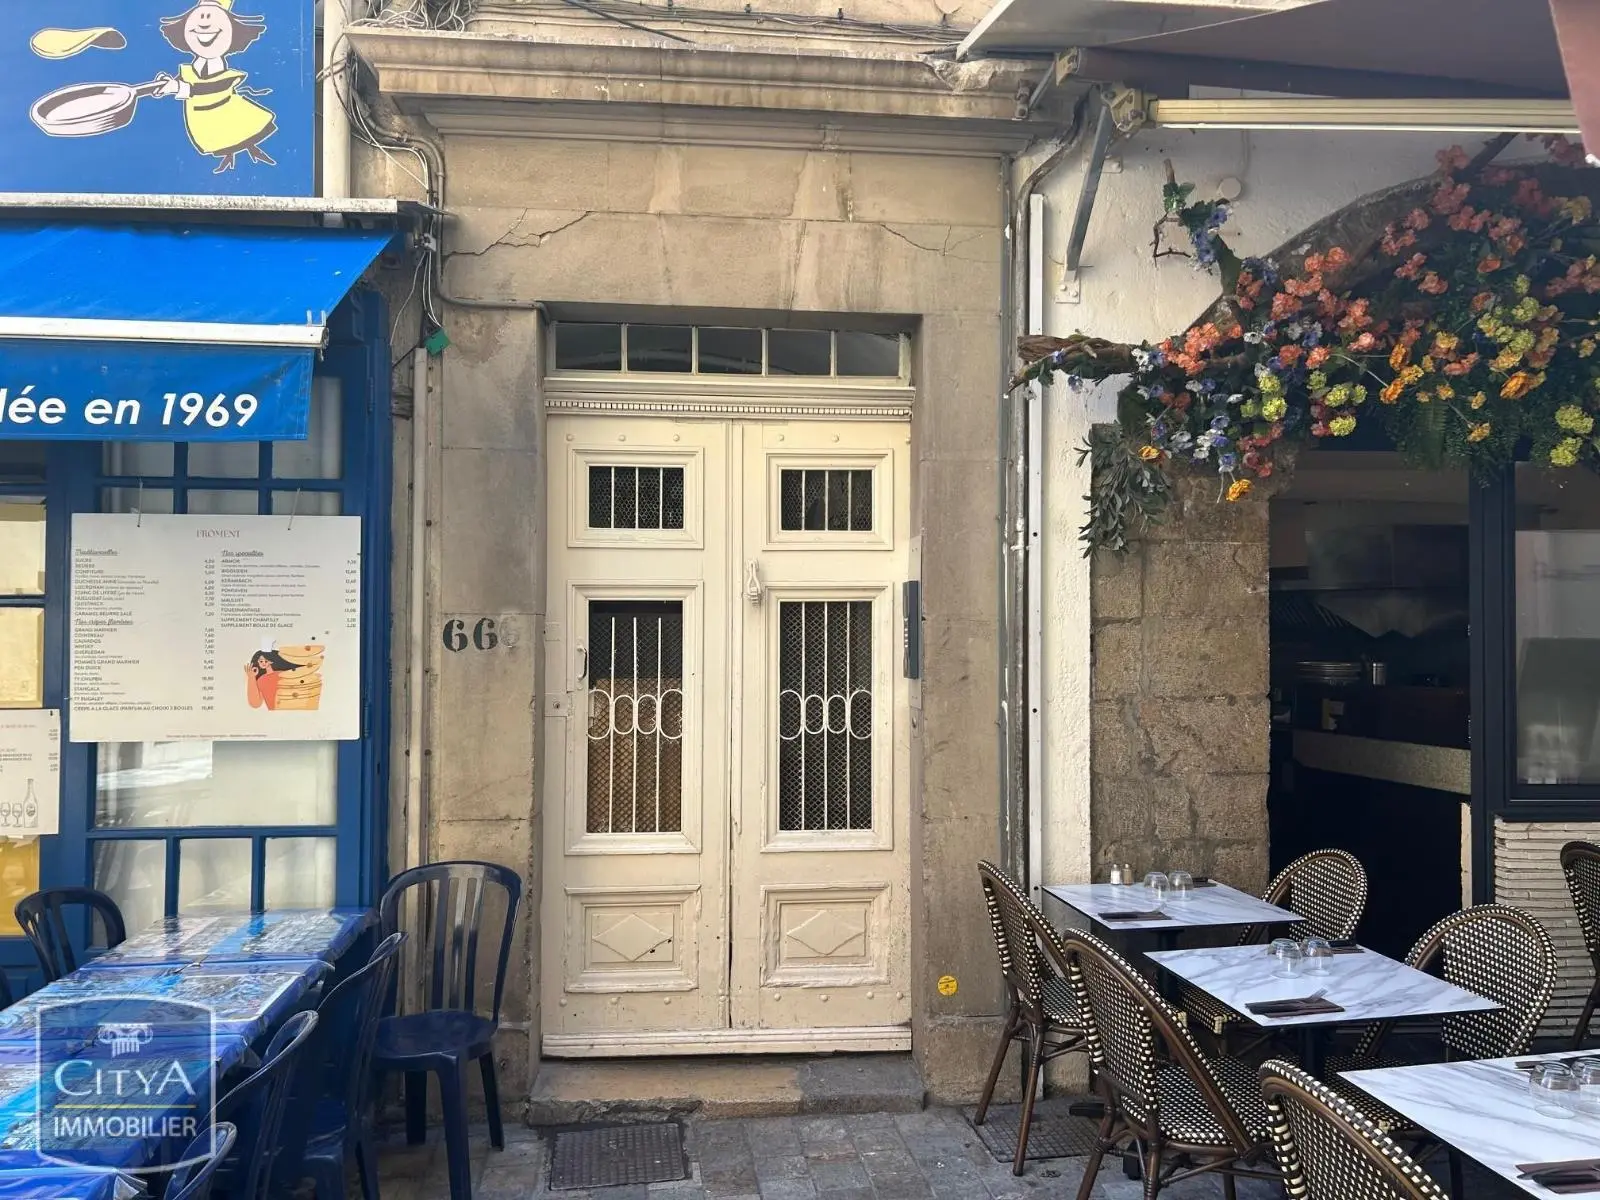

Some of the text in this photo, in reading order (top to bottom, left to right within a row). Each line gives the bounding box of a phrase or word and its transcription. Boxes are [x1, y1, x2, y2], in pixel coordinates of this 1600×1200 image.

[84, 398, 141, 425] en
[162, 392, 258, 427] 1969
[196, 529, 240, 538] FROMENT
[442, 617, 498, 652] 66
